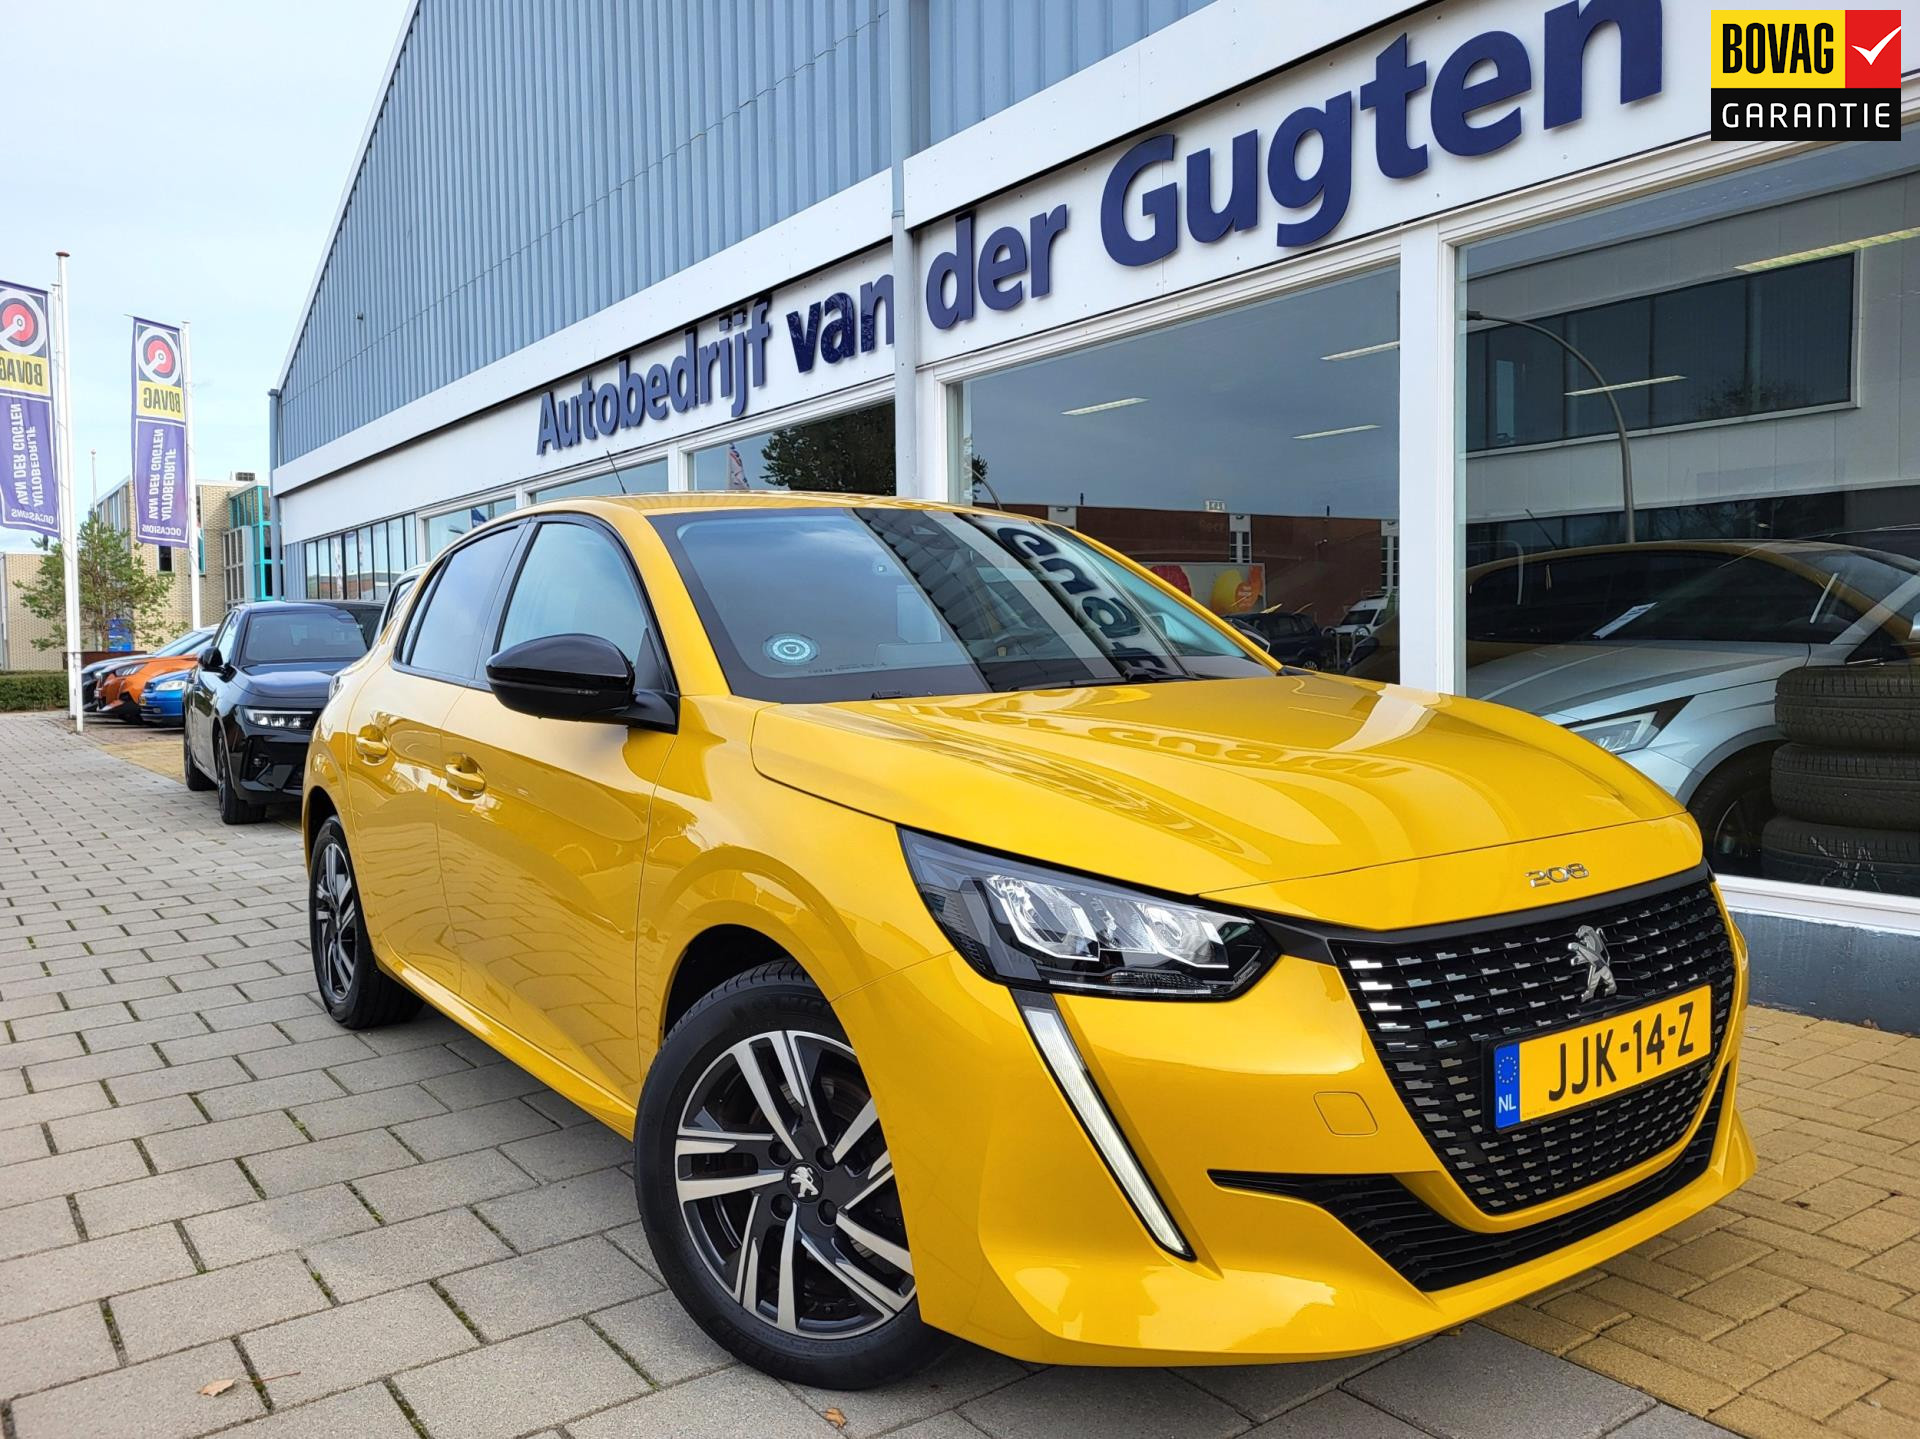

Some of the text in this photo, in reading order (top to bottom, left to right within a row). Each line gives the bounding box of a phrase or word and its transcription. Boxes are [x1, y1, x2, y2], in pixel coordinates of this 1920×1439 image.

[537, 0, 1663, 455] Autobedrijf van der Gugten
[1524, 863, 1589, 888] 208
[1548, 1001, 1694, 1102] JJK-14-Z
[1498, 1093, 1516, 1113] NL
